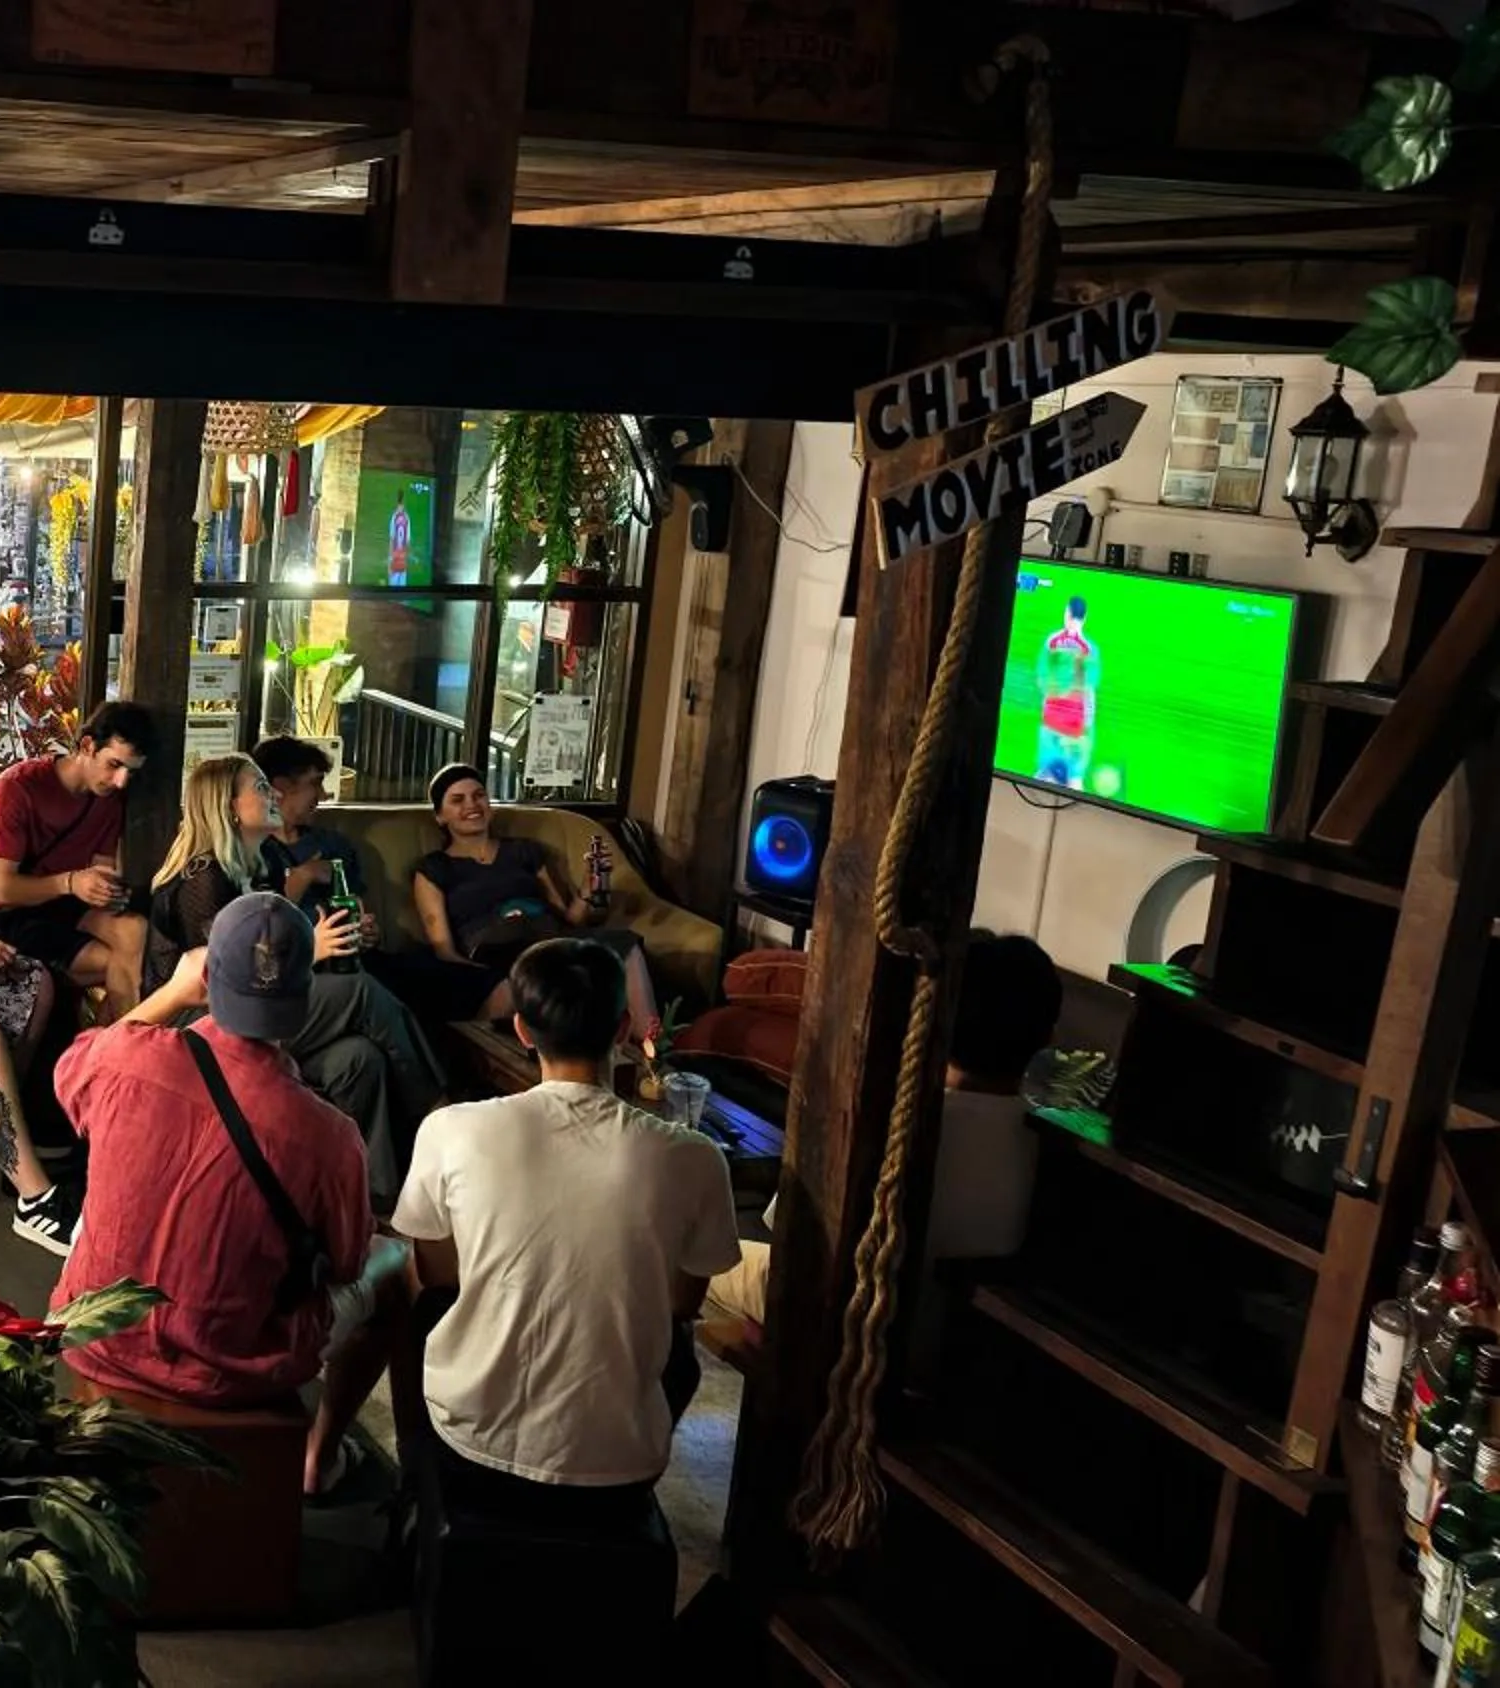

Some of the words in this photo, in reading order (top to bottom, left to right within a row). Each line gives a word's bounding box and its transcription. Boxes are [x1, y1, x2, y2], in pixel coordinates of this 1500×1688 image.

[868, 291, 1159, 451] CHILLING
[882, 418, 1069, 560] MOVIE
[1071, 441, 1120, 479] ZONE
